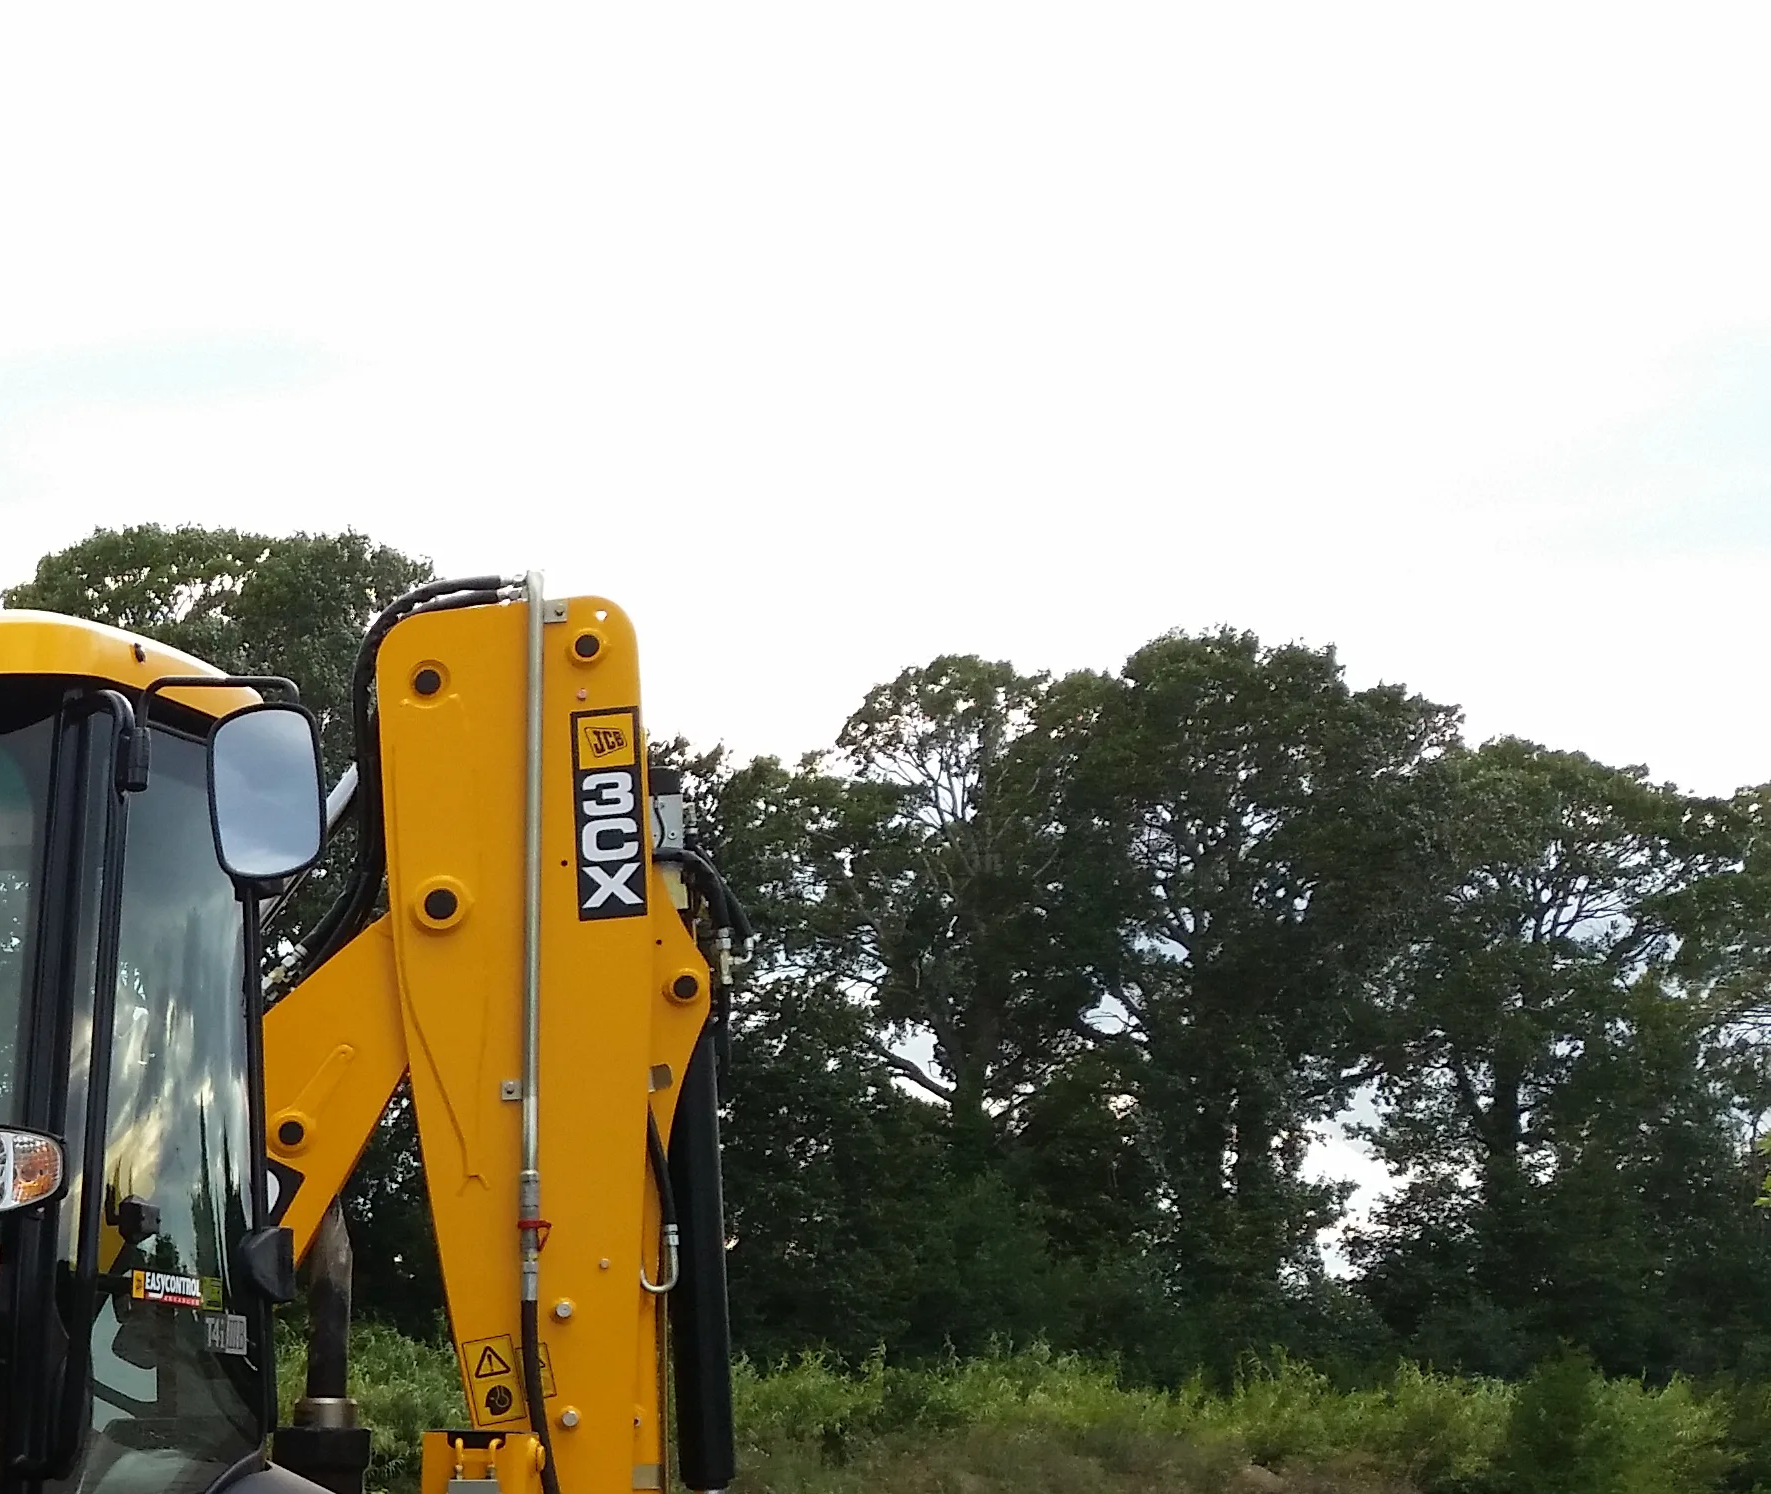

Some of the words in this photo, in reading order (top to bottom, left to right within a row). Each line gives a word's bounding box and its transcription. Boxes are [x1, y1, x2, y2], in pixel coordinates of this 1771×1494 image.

[592, 731, 624, 754] JCB
[582, 771, 644, 909] 3CX
[145, 1271, 202, 1298] EASYCONTROL
